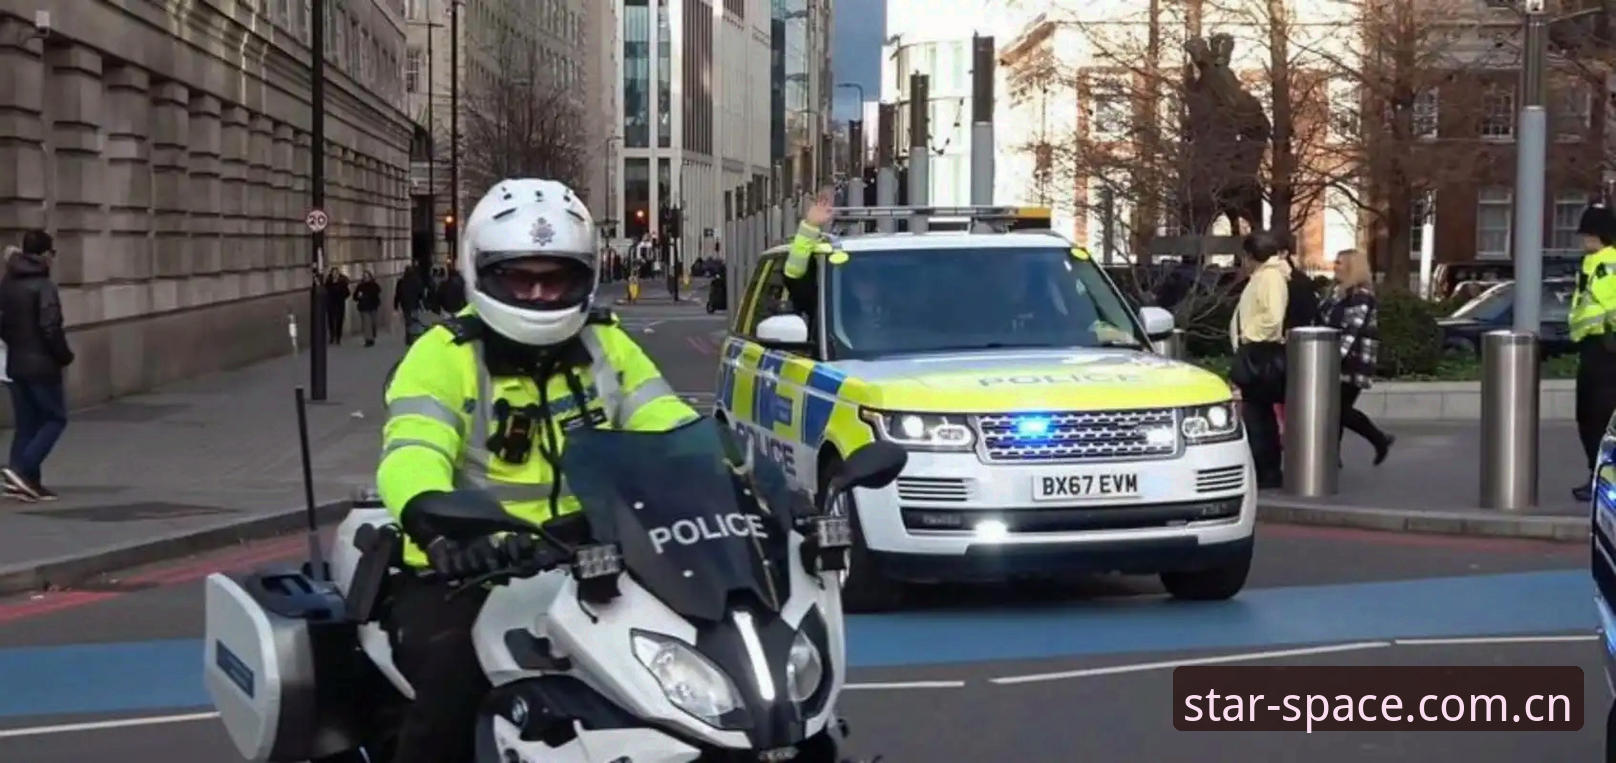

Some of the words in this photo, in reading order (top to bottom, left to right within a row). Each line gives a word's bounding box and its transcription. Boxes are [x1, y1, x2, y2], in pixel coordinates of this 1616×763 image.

[309, 214, 326, 226] 20
[978, 374, 1144, 387] POLICE
[1042, 475, 1094, 496] BX67
[1099, 473, 1138, 494] EVM
[648, 512, 769, 554] POLICE
